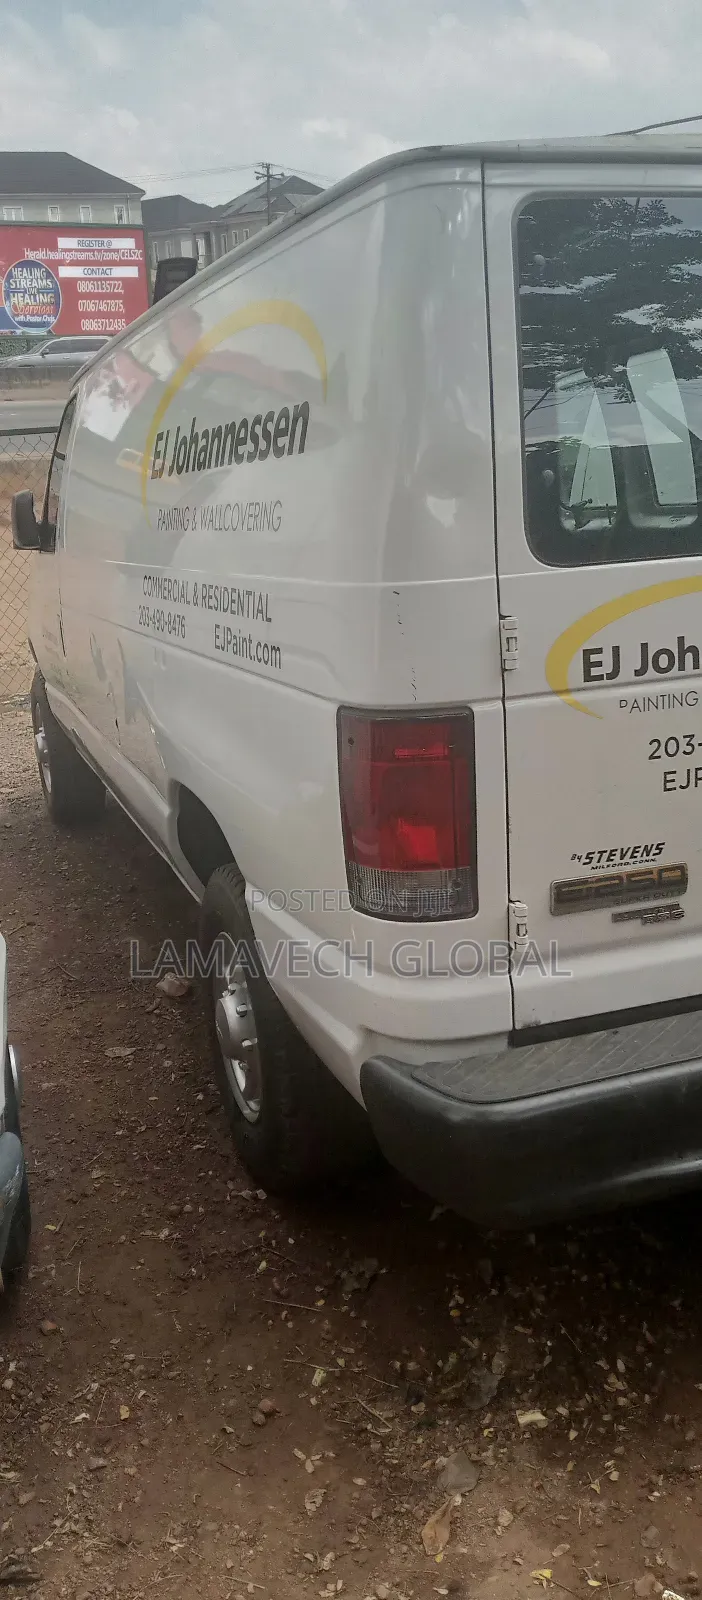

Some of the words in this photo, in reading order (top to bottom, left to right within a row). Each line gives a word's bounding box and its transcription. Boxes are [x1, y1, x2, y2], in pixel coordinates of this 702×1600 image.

[77, 240, 105, 248] REGISTER
[106, 240, 112, 248] @
[12, 268, 46, 279] HEALING
[83, 268, 113, 276] CONTACT
[10, 279, 53, 288] STREAMS
[77, 281, 124, 294] 08061135722,
[10, 293, 55, 305] HEALING
[78, 300, 125, 313] 07067467875,
[151, 430, 170, 479] EJ
[168, 401, 309, 477] Johannessen
[157, 506, 190, 531] PAINTING
[191, 507, 197, 531] &
[201, 500, 282, 532] WALLCOVERING
[143, 575, 190, 605] COMMERCIAL
[193, 582, 198, 607] &
[201, 583, 272, 623] RESIDENTIAL
[138, 605, 186, 639] 203-490-8476
[214, 624, 282, 669] EJPaint.com
[582, 646, 620, 682] EJ
[634, 636, 700, 677] Joh
[619, 691, 699, 713] PAINTING
[582, 842, 666, 865] STEVENS
